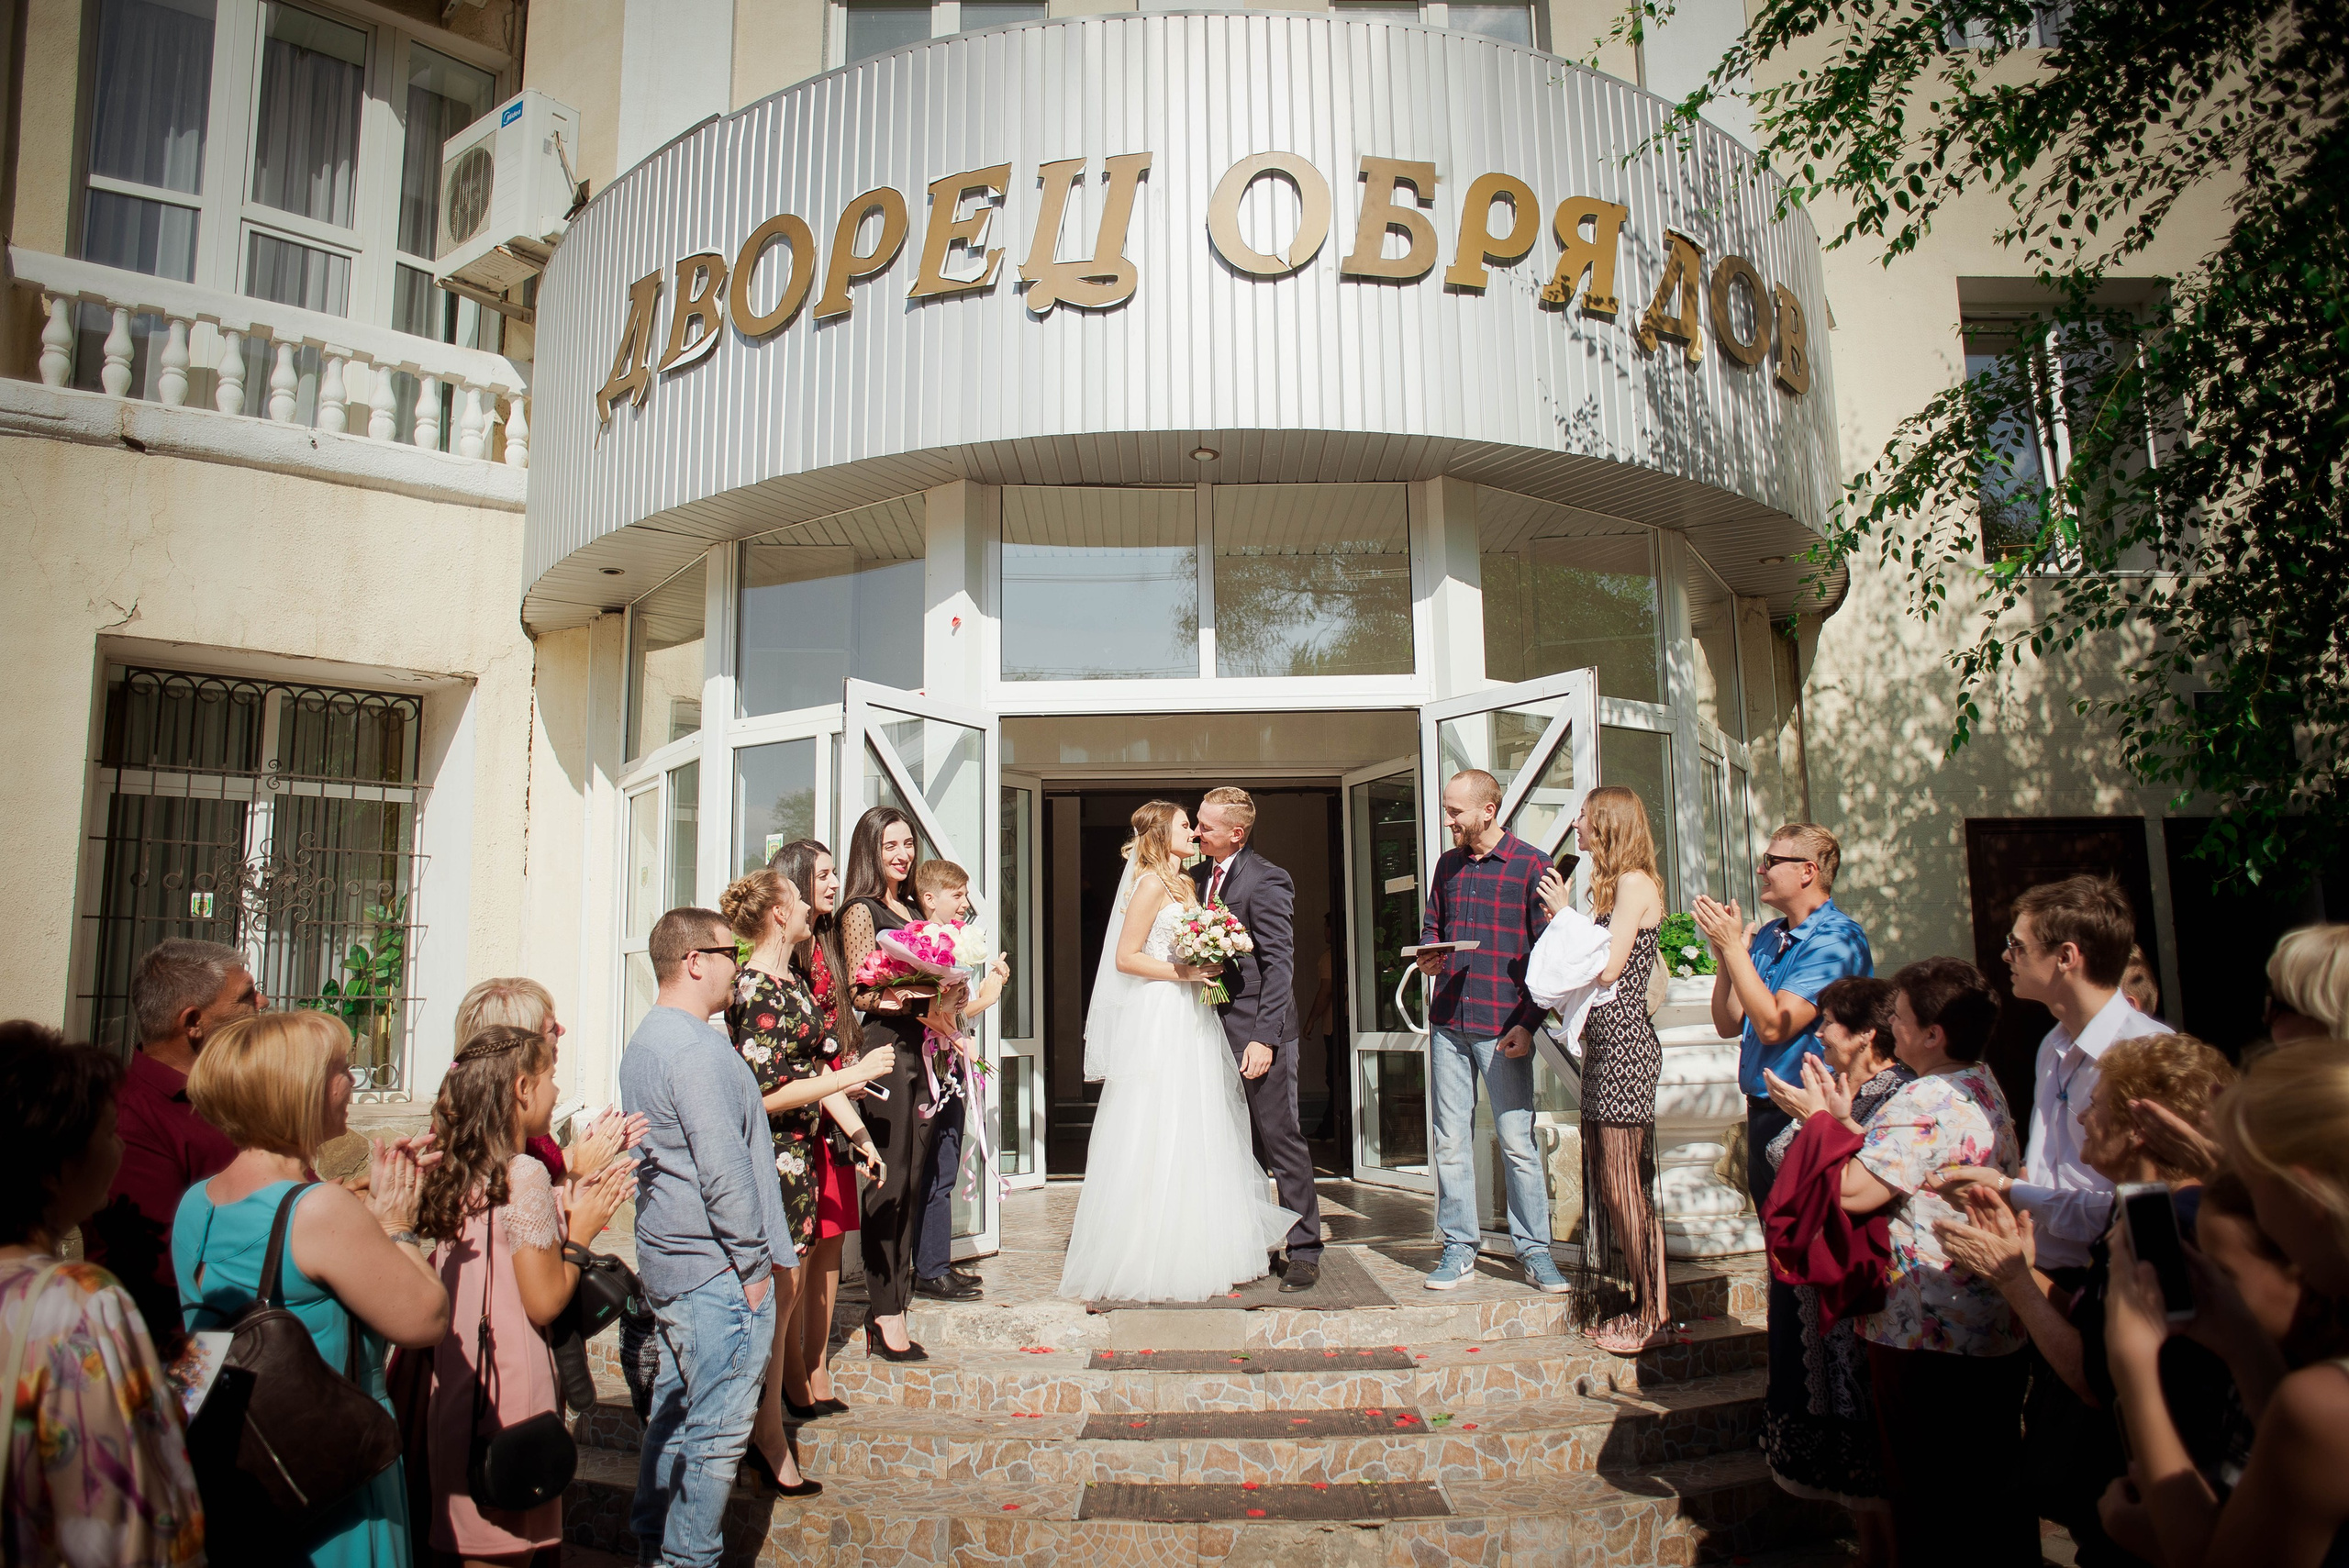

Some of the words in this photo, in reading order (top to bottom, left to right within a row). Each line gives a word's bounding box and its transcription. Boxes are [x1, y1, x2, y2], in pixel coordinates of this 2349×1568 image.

[503, 109, 521, 125] Midea
[596, 151, 1153, 424] ДВОРЕЦ
[1208, 151, 1809, 395] ОБРЯДОВ
